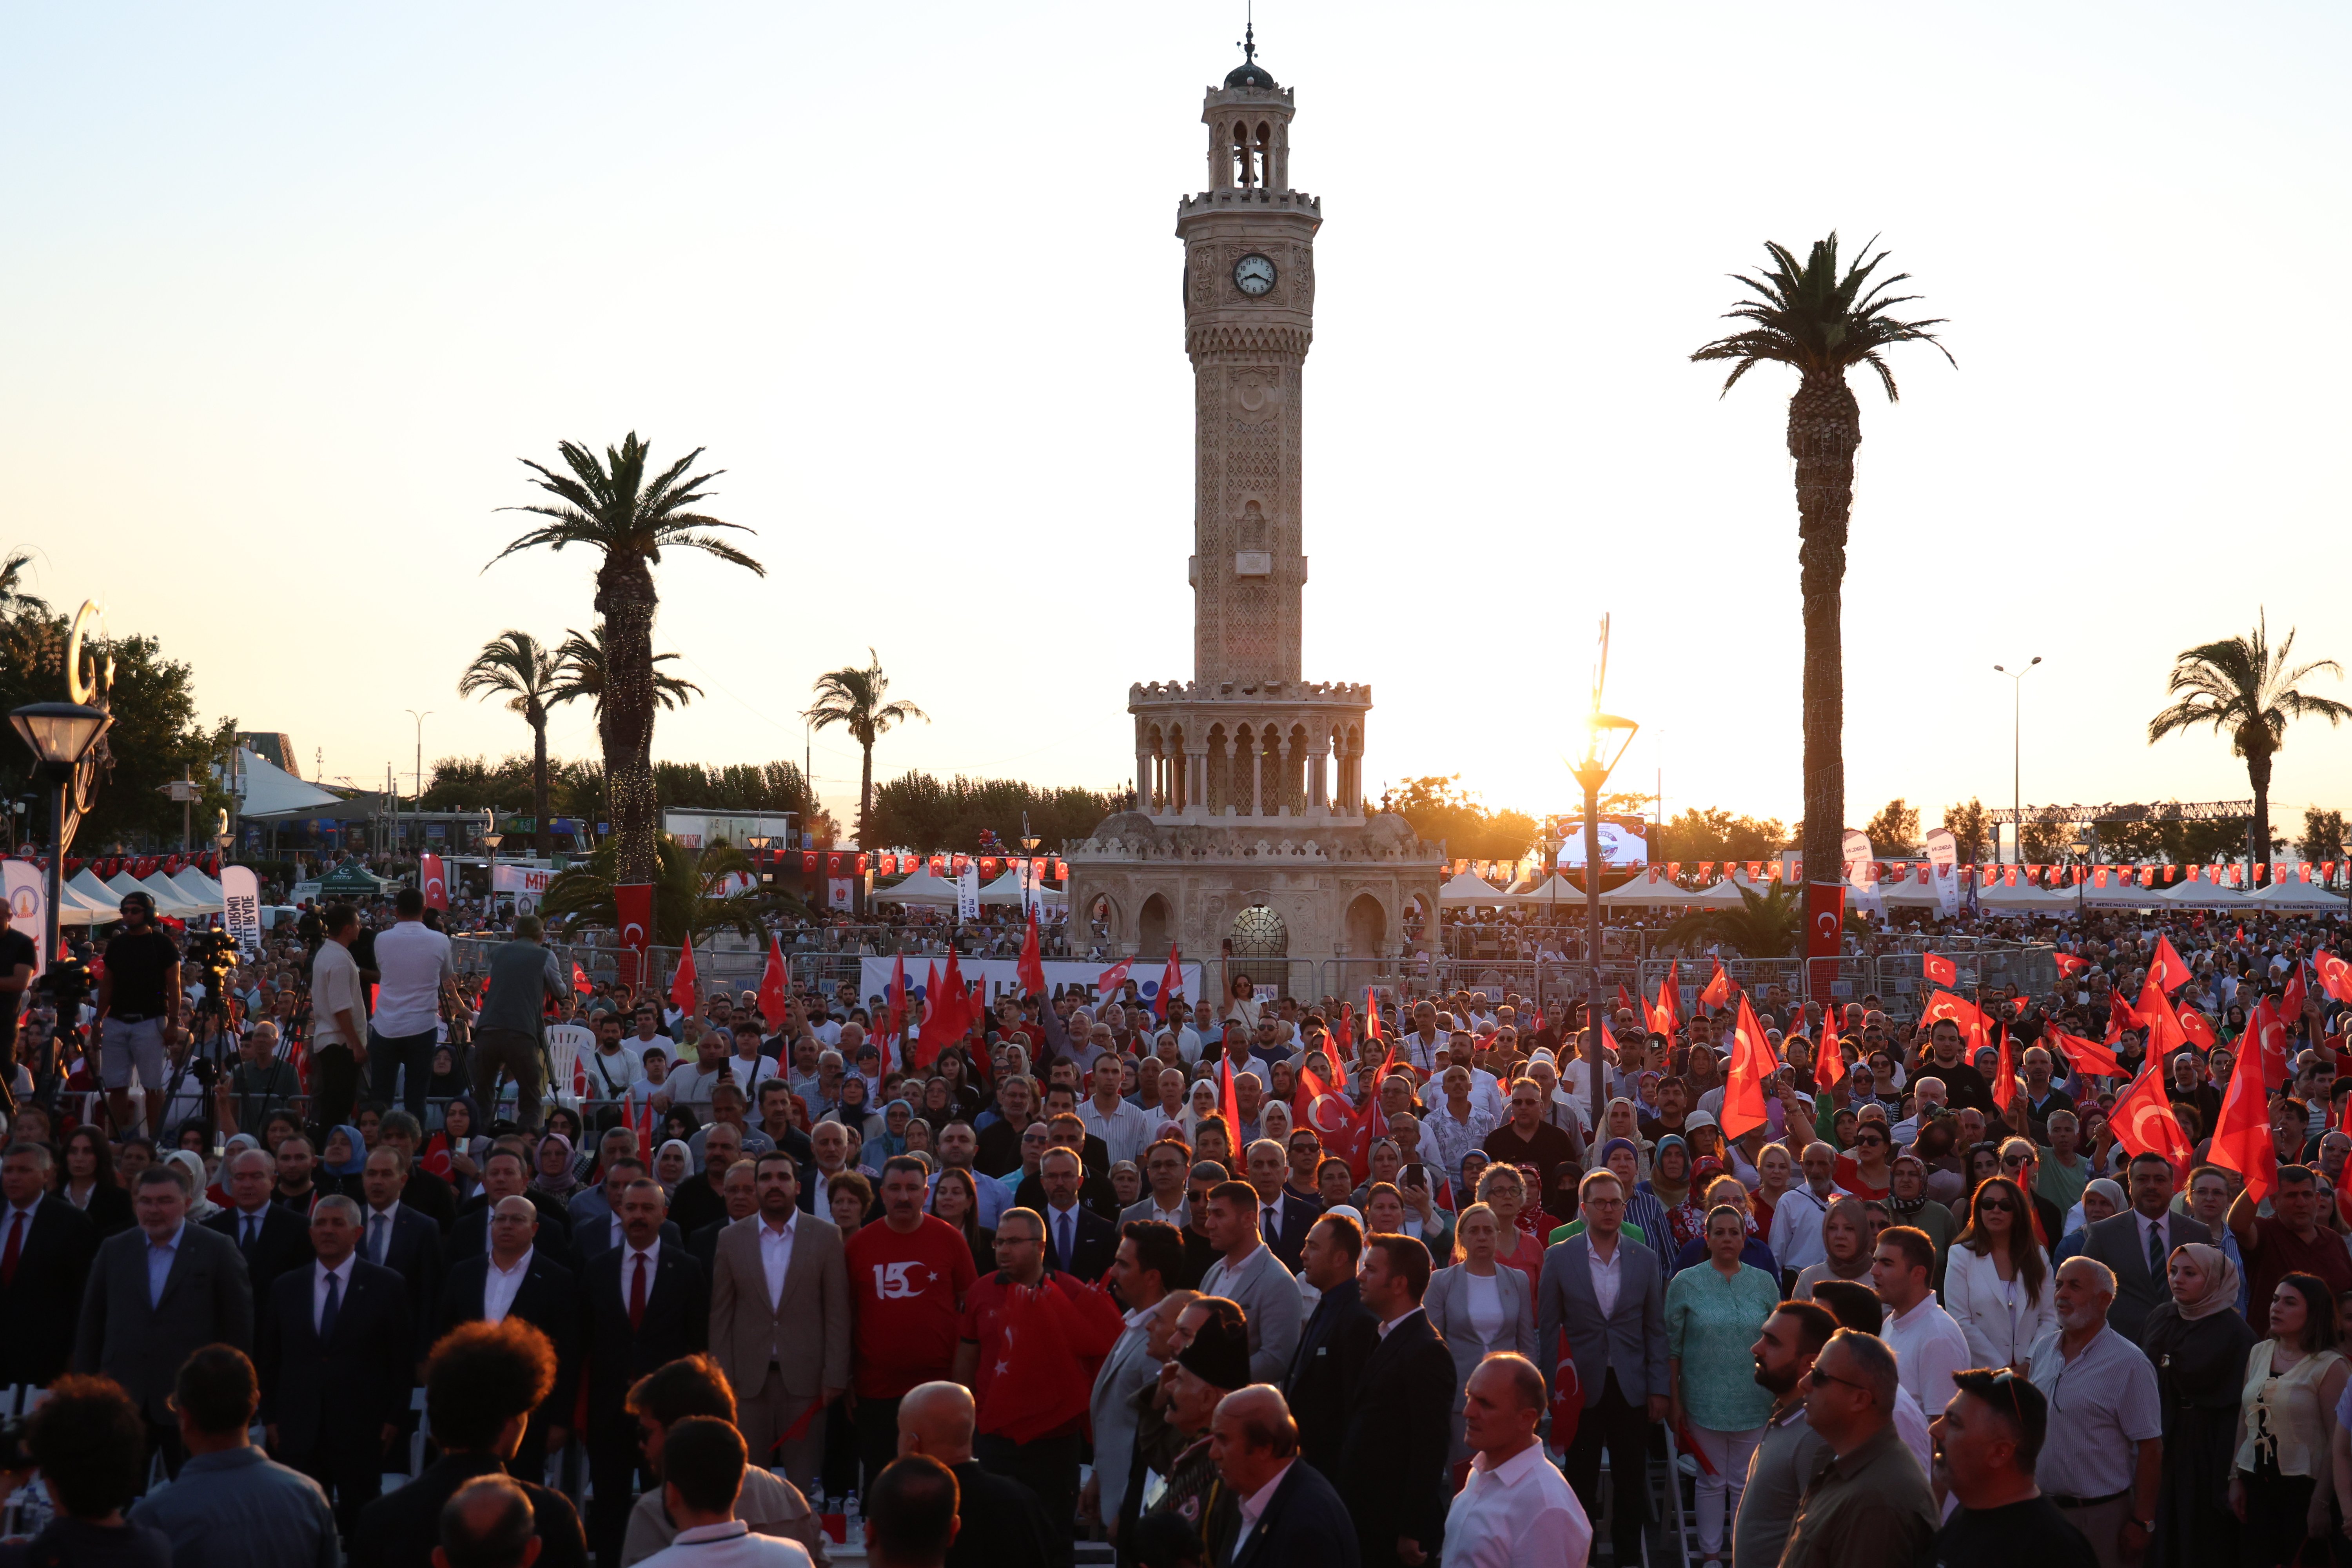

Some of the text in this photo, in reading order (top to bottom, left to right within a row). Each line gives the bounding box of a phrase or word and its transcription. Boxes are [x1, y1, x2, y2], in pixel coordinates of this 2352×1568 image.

[686, 834, 701, 848] BİZİM
[771, 836, 784, 849] BİZİM
[735, 978, 755, 990] POLİS
[822, 982, 835, 992] POL
[1833, 983, 1851, 995] POLİS
[1897, 980, 1910, 991] POLİS
[873, 1261, 912, 1299] 15
